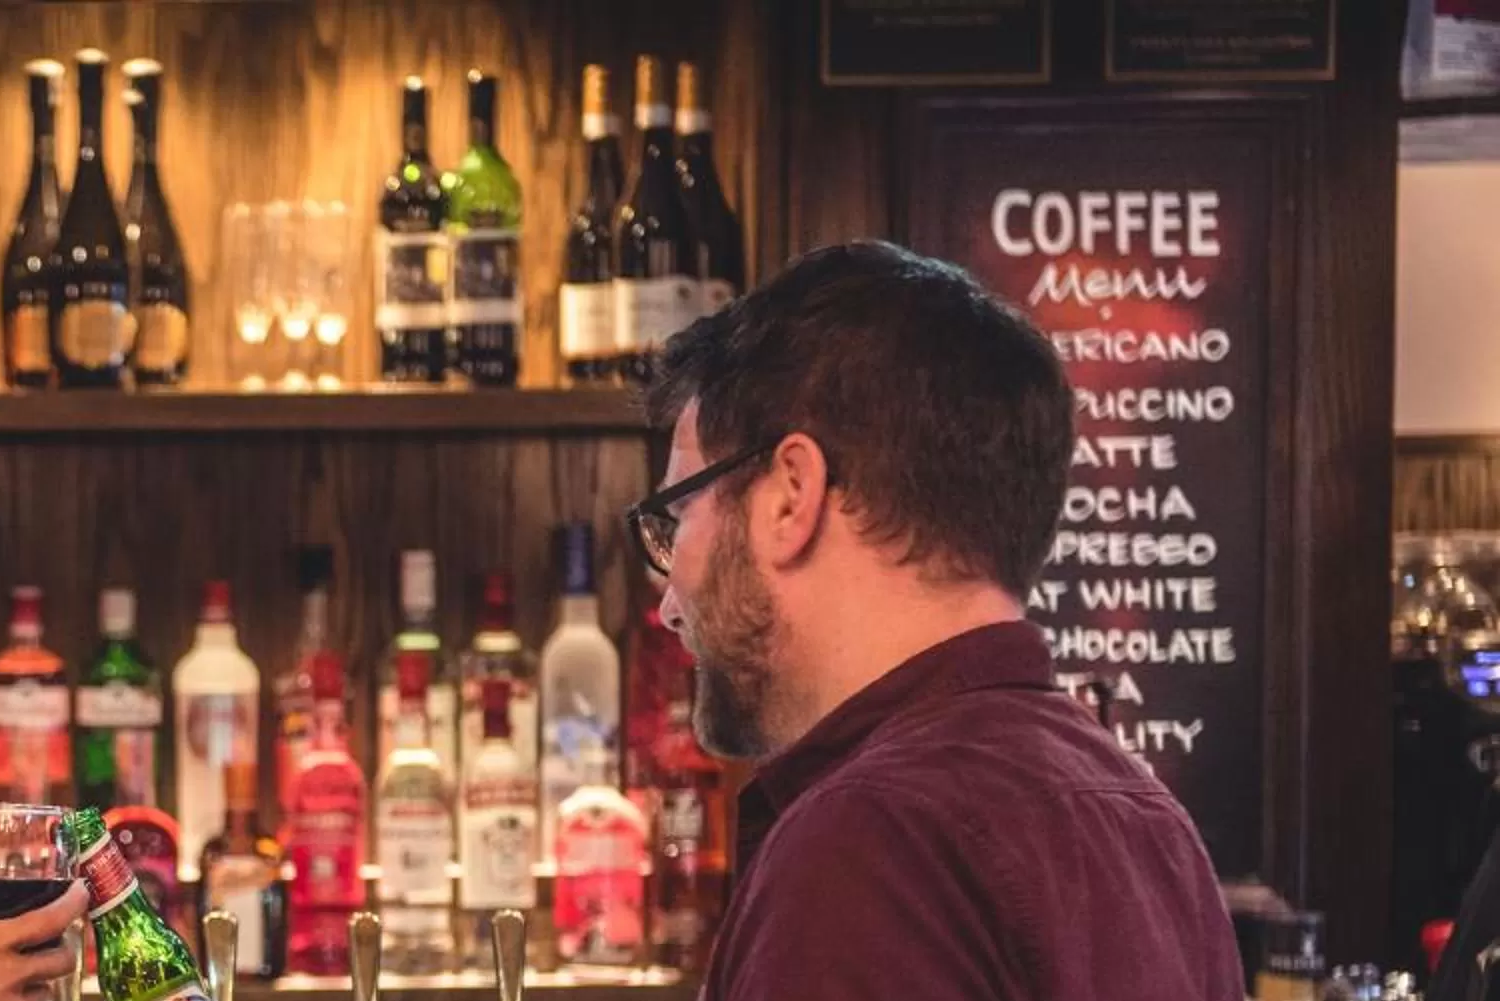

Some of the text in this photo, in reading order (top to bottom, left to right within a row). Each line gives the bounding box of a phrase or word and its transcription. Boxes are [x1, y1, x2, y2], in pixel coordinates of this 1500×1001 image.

[991, 188, 1221, 258] COFFEE
[1027, 261, 1208, 307] Menu
[1052, 328, 1230, 363] ERICANO
[1075, 386, 1234, 422] PUCCINO
[1070, 434, 1178, 470] ATTE
[1063, 485, 1196, 522] OCHA
[1053, 529, 1217, 567] PRESSO
[1027, 575, 1218, 614] AT WHITE
[1055, 671, 1145, 706] TA
[1114, 718, 1204, 754] LITY
